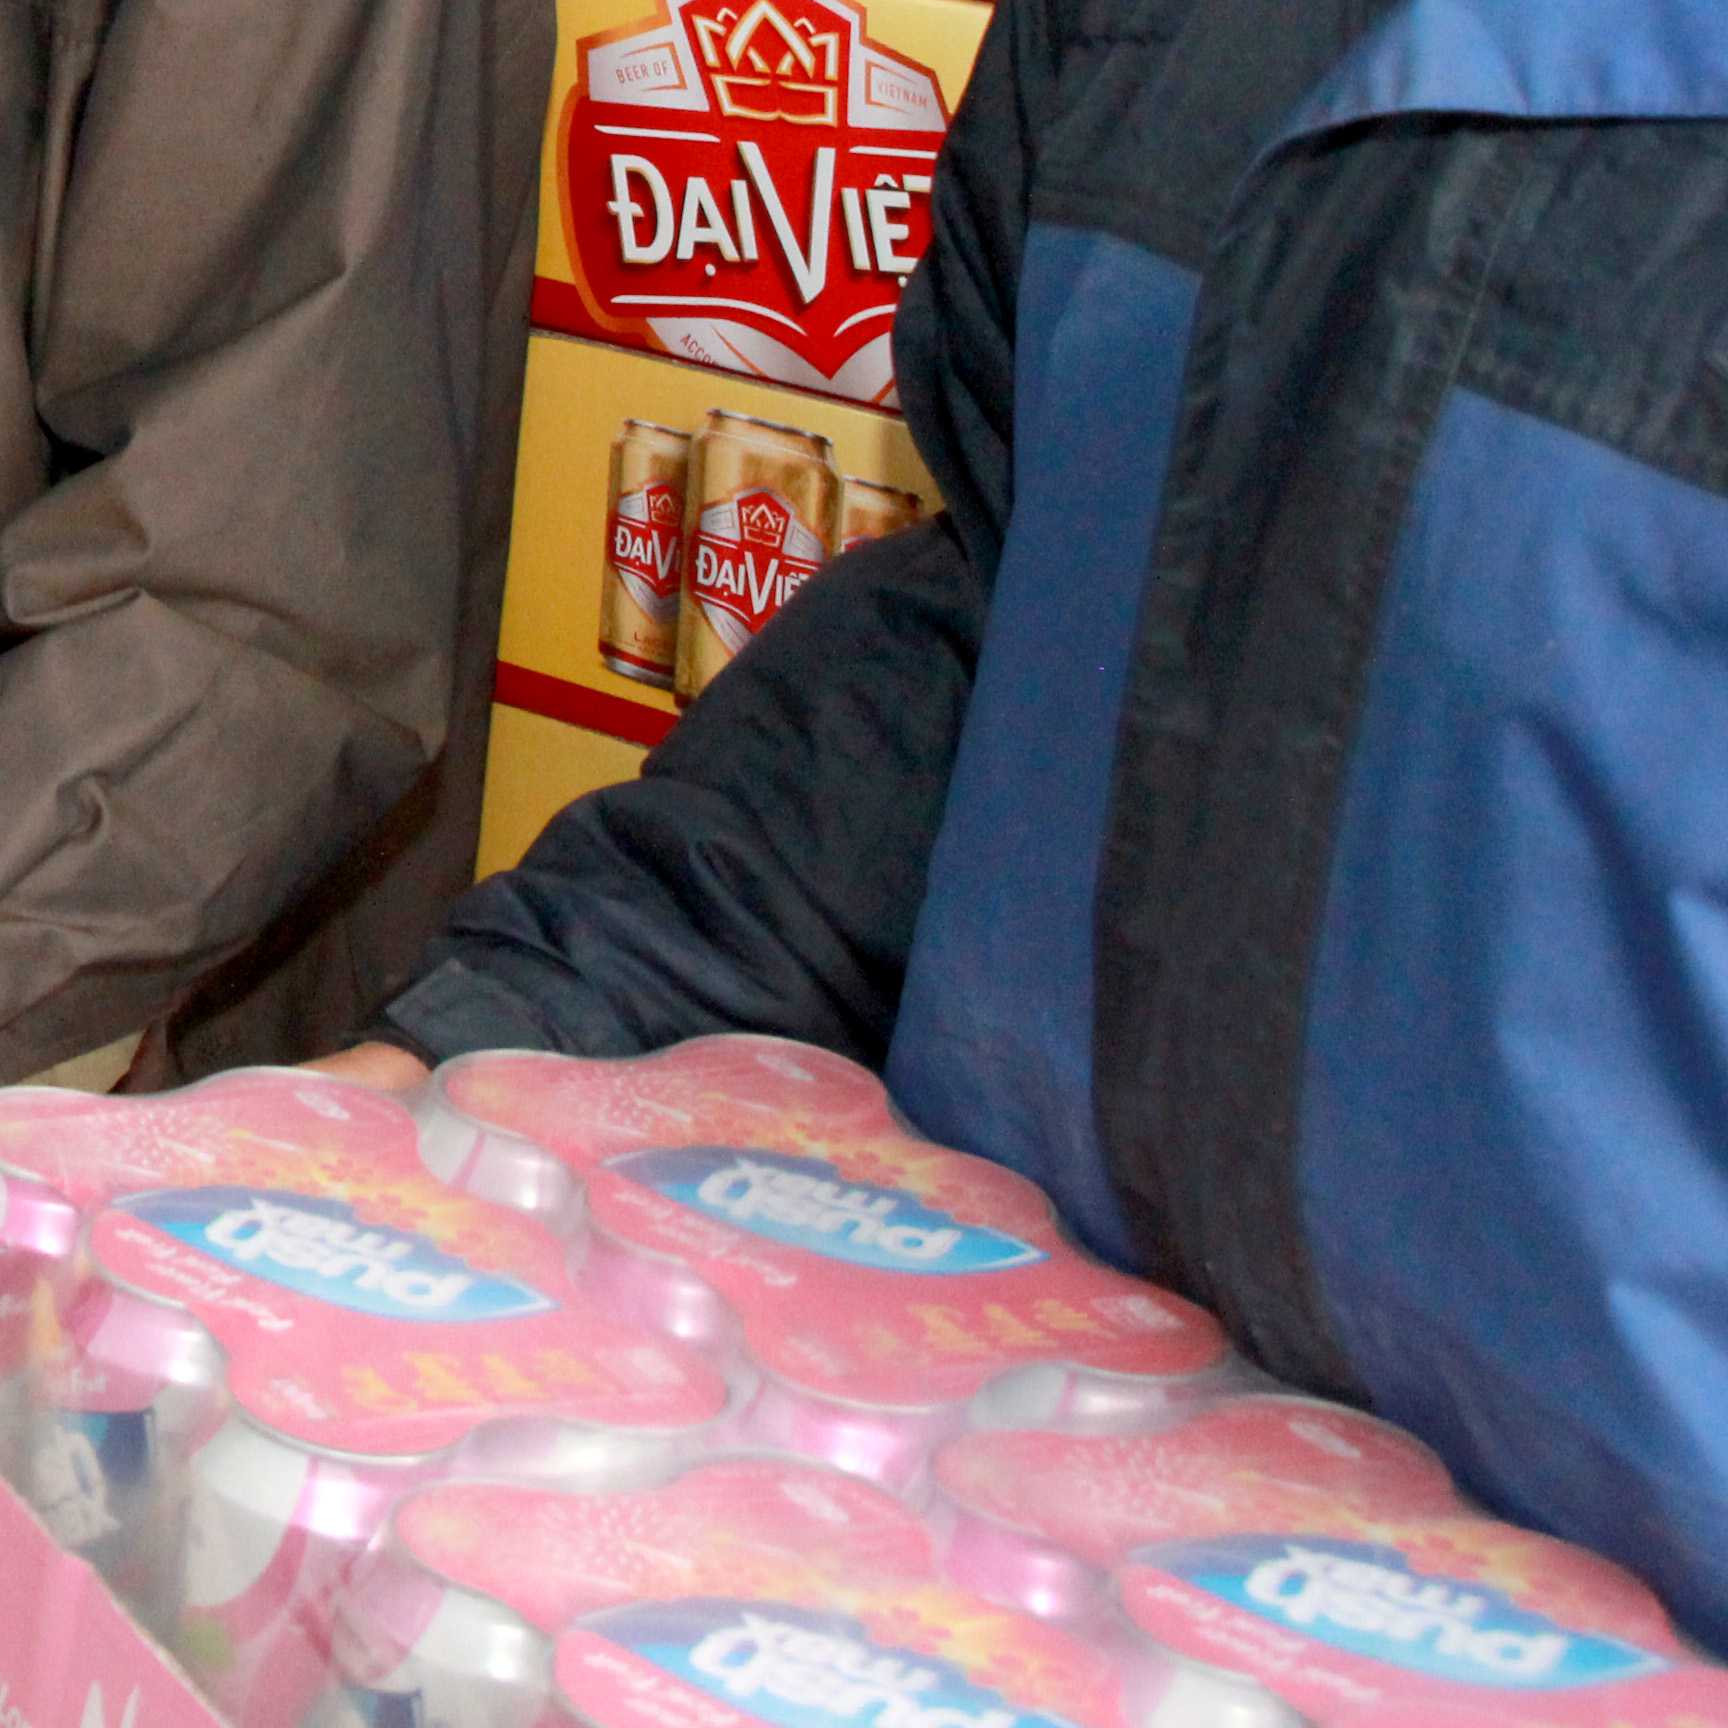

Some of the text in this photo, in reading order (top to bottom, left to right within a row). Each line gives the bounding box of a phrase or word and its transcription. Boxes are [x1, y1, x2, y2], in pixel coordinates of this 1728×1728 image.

[615, 62, 668, 84] BEER OF
[877, 83, 929, 108] VIETNAM
